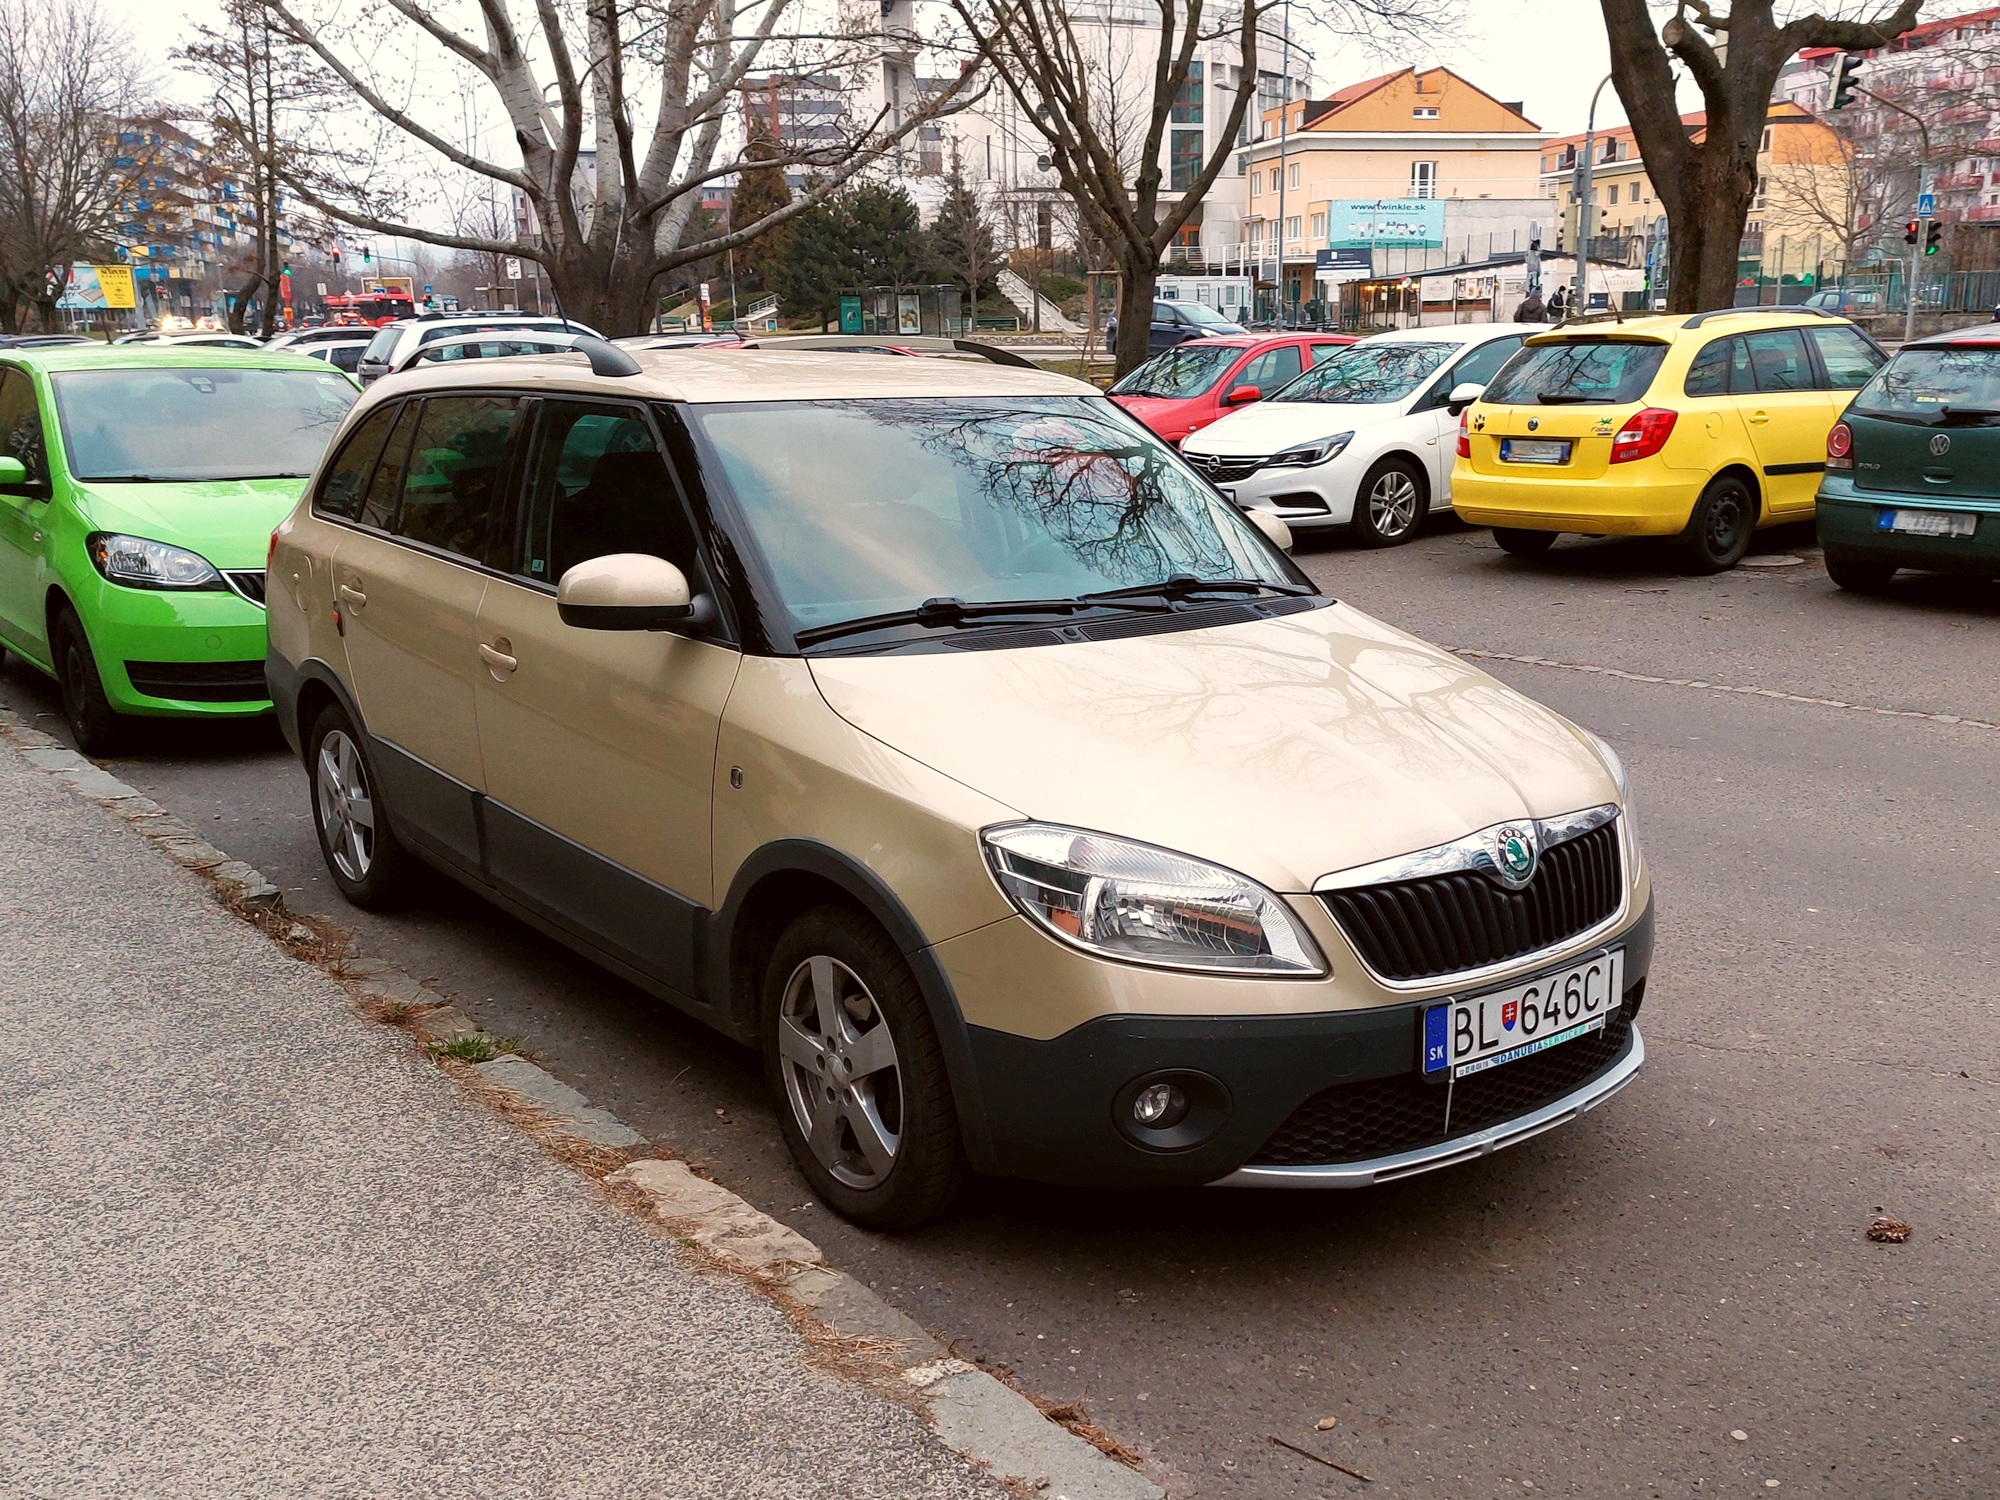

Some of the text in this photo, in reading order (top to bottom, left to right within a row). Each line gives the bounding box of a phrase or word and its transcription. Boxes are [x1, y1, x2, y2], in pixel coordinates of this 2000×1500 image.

[1350, 203, 1426, 211] wwwtwinkle.sk
[1858, 462, 1881, 470] POLO
[1454, 958, 1615, 1058] BL 646CI
[1429, 1046, 1444, 1061] SK
